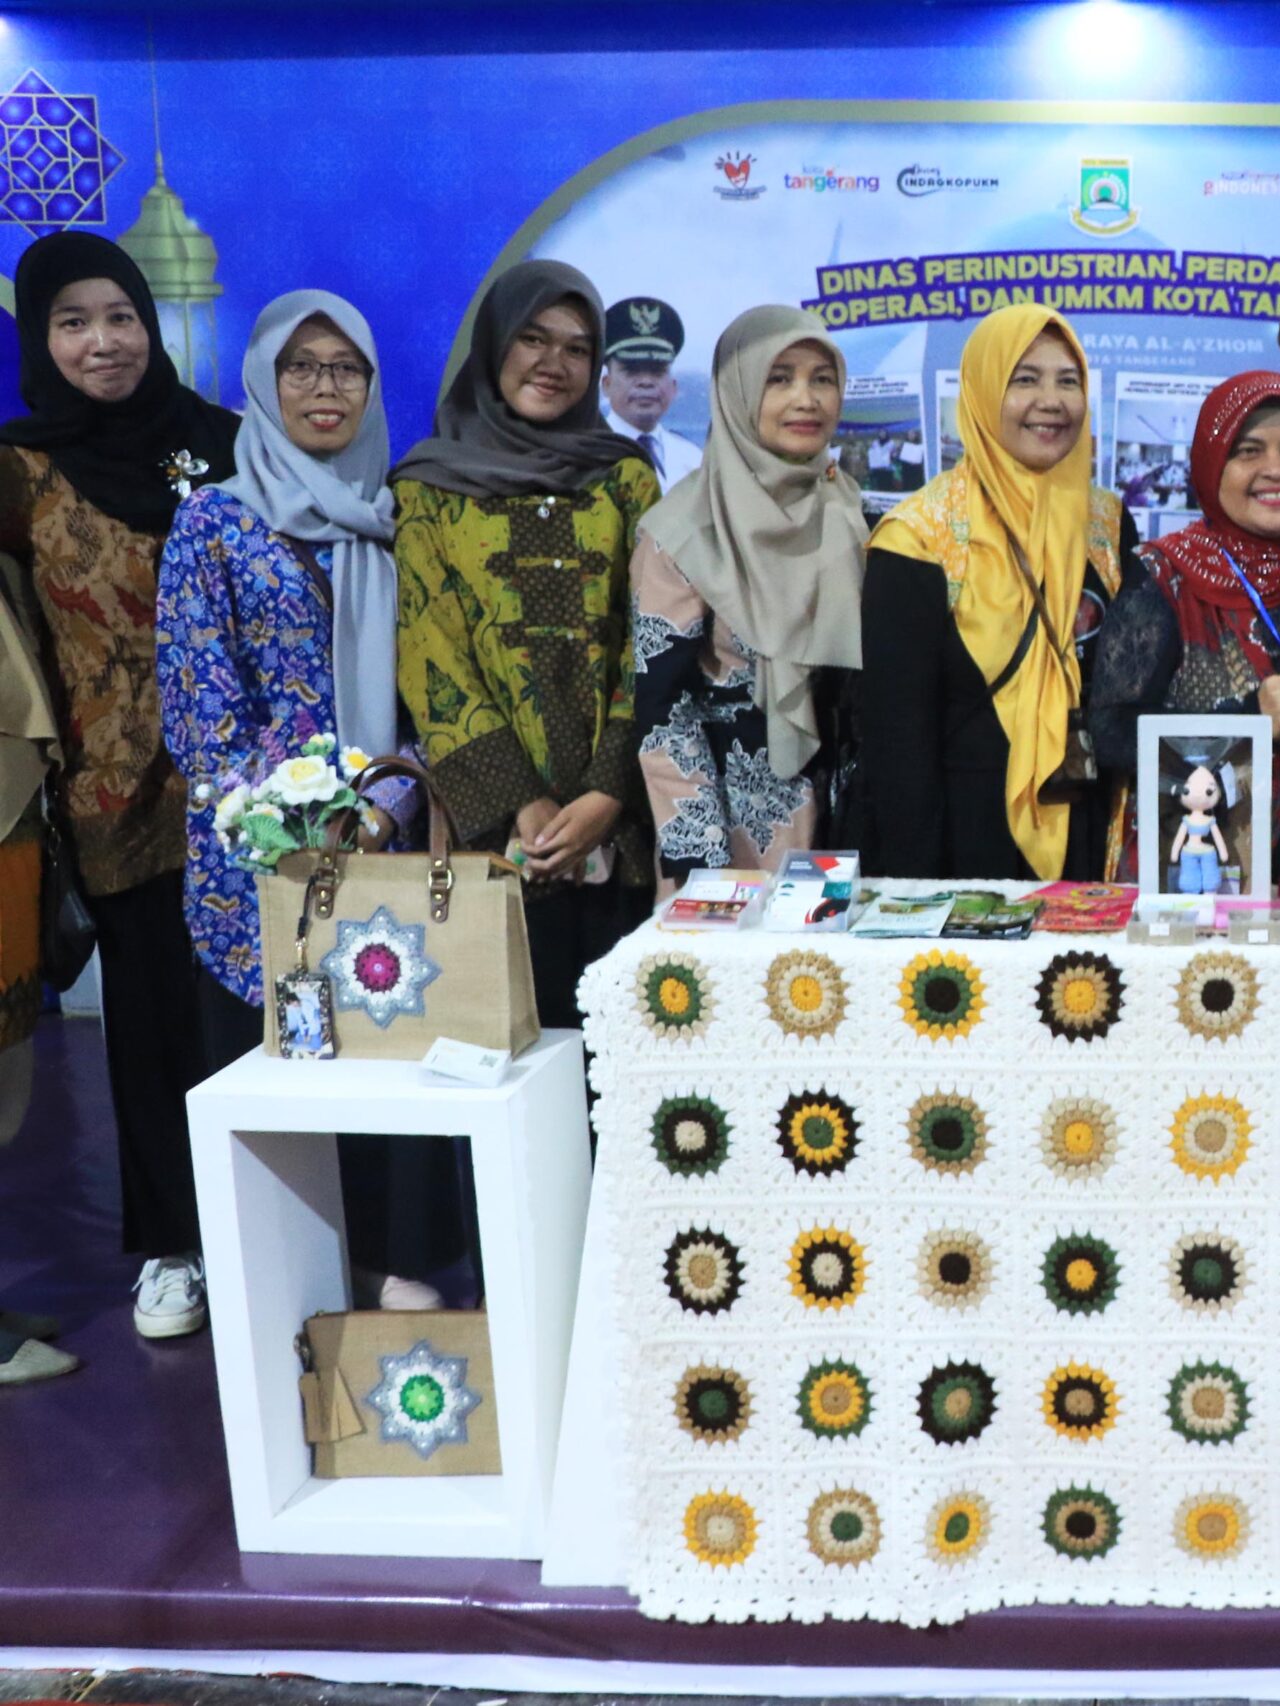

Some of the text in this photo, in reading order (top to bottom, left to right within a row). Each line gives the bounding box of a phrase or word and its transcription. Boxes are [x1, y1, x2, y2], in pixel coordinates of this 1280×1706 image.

[784, 172, 880, 192] tangerang
[904, 176, 1000, 188] INDAGKOPUKM
[822, 262, 917, 296] DINAS
[925, 254, 1177, 285] PERINDUSTRIAN,
[970, 286, 1035, 313] DAN
[1043, 285, 1144, 309] UMKM
[1153, 285, 1230, 314] KOTA
[1083, 334, 1138, 349] RAYA
[1116, 355, 1196, 367] TANGERANG
